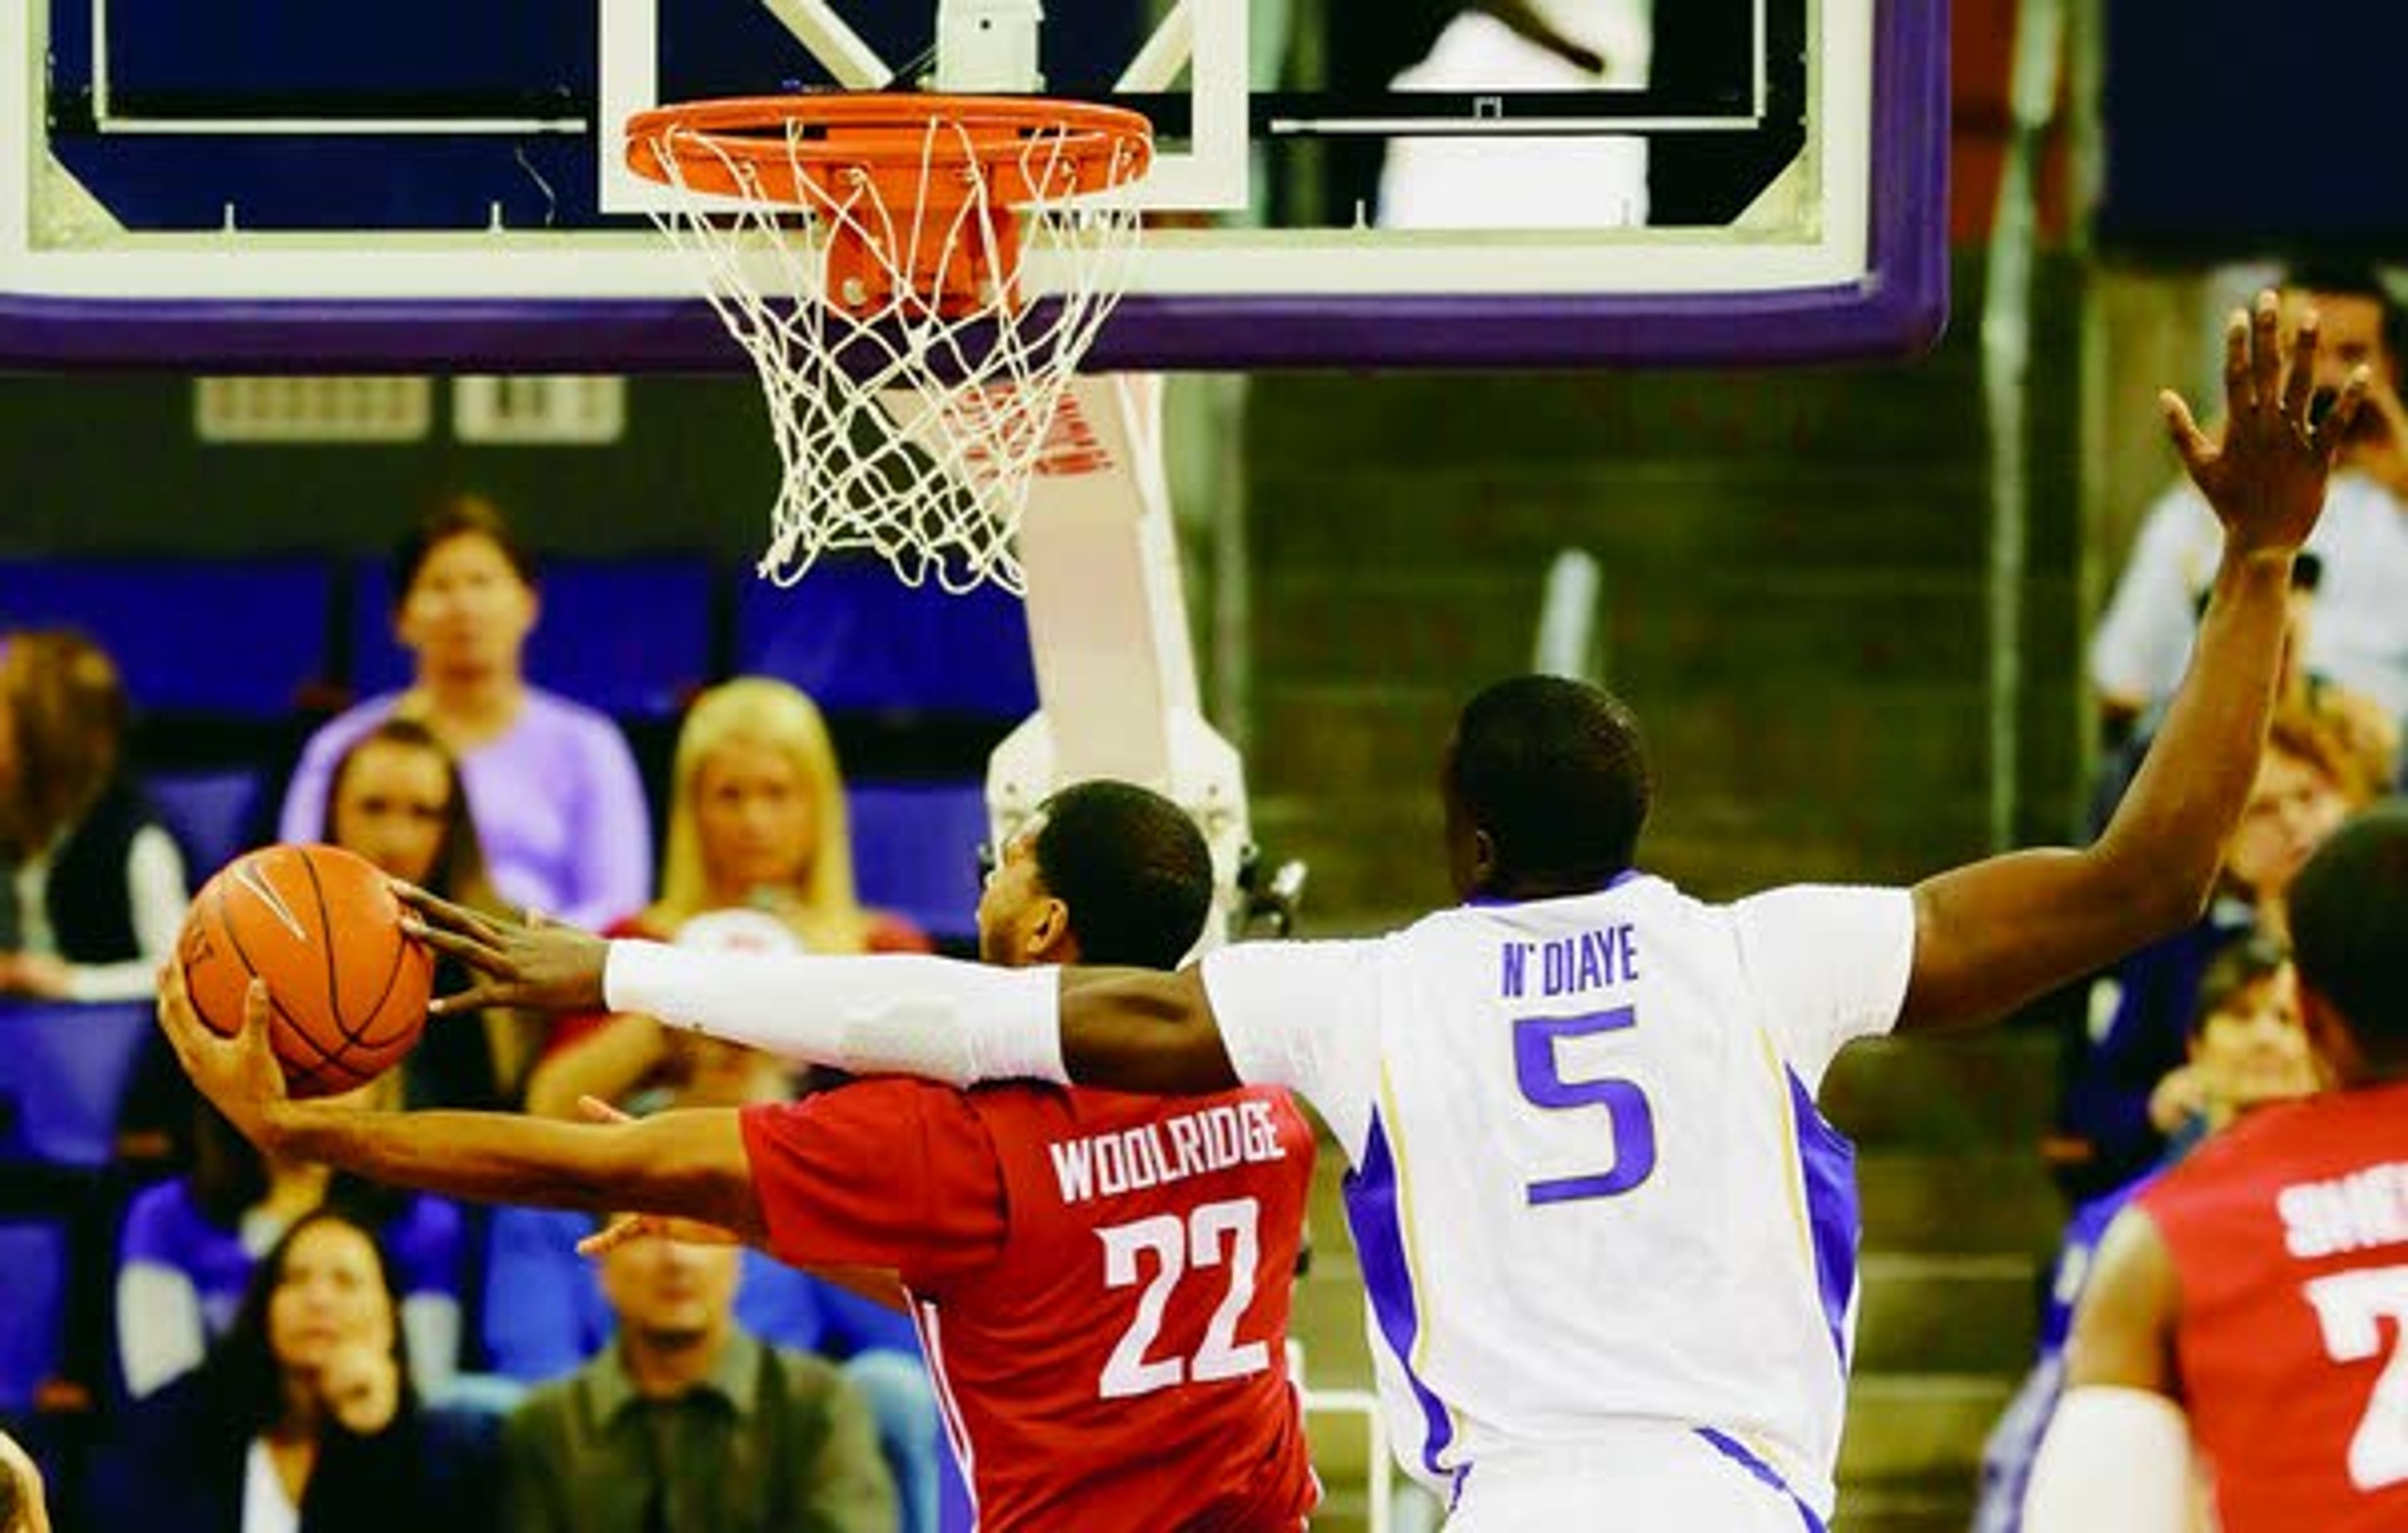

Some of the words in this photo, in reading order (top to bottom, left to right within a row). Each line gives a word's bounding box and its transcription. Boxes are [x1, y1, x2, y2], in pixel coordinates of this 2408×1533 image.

[1049, 1099, 1287, 1203] WOOLRIDGE
[1513, 1004, 1657, 1206] 5
[1091, 1196, 1270, 1399] 22
